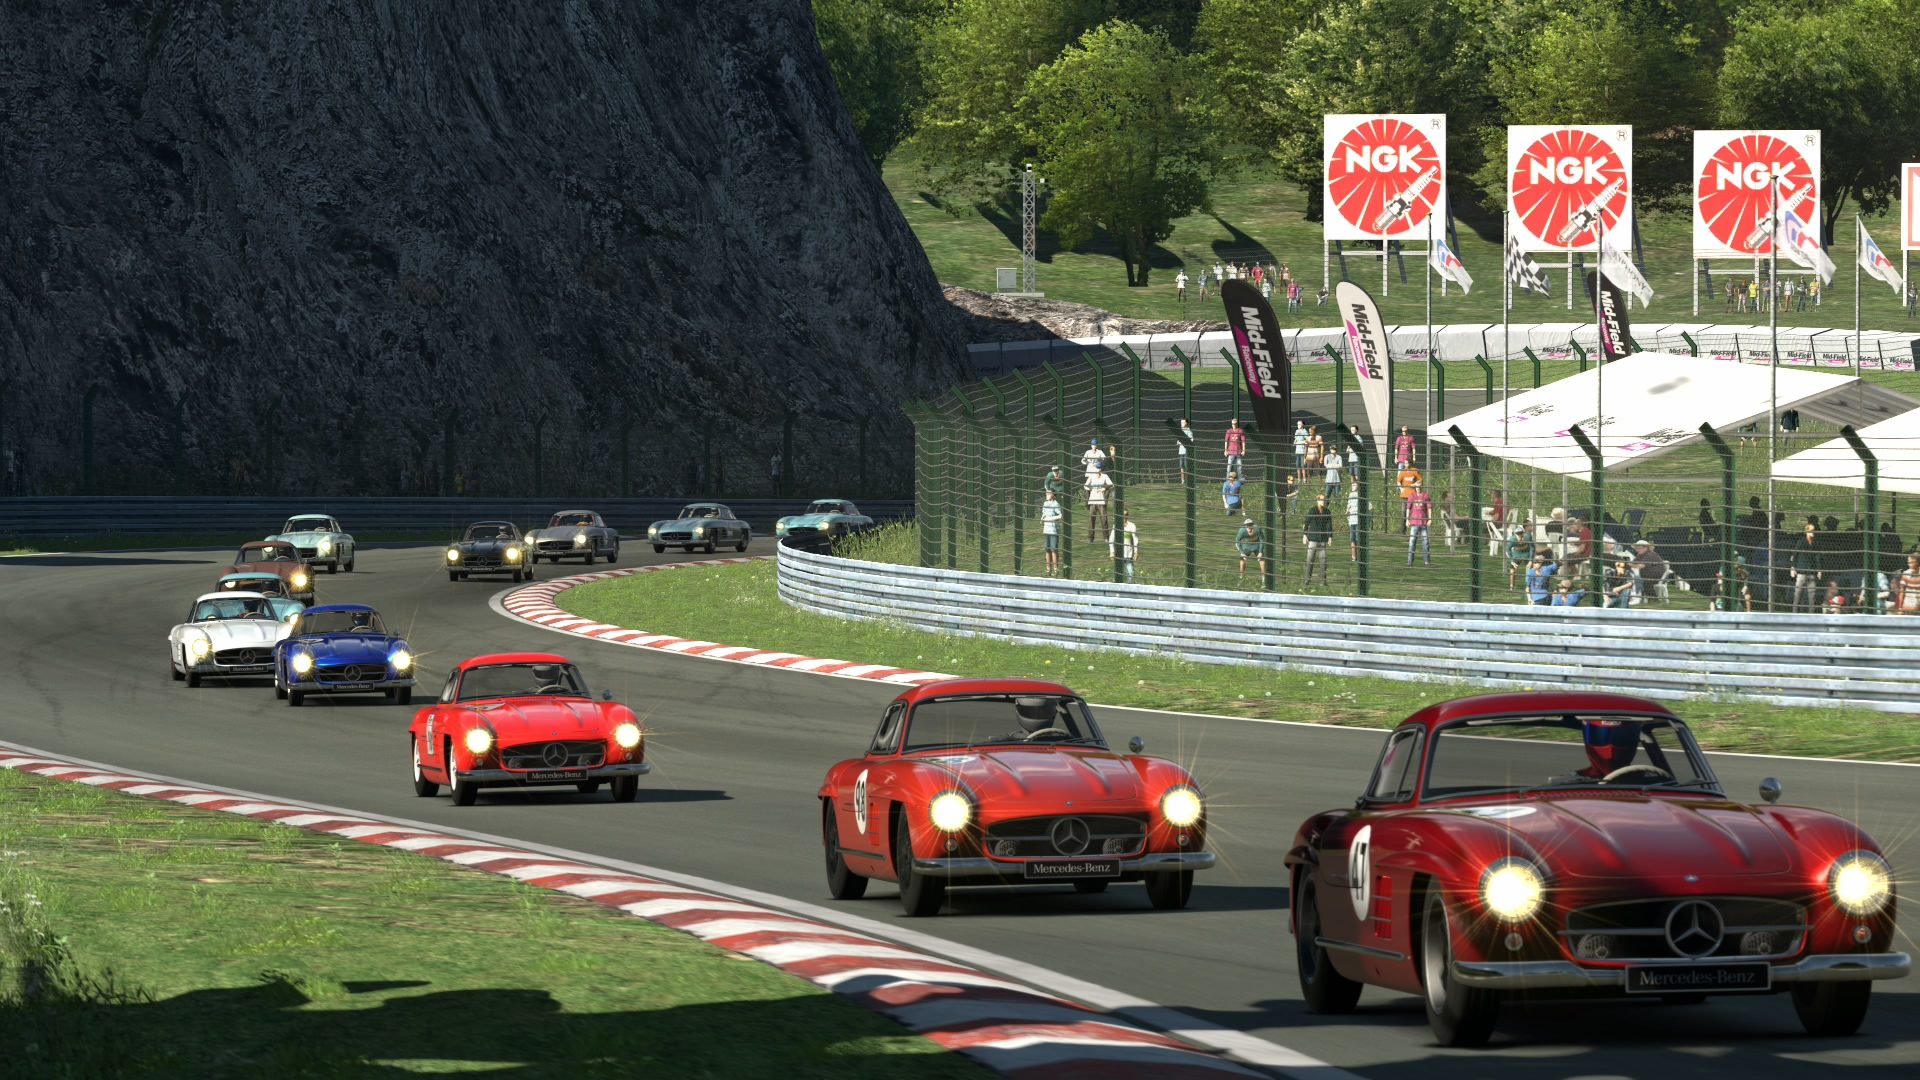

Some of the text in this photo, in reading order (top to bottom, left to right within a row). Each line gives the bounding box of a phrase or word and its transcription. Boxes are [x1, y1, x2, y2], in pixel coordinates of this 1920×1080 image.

[1345, 144, 1423, 174] NGK
[1529, 155, 1609, 186] NGK
[1716, 160, 1796, 191] NGK
[1601, 290, 1626, 355] Mid-Field
[1240, 306, 1281, 399] Mid-Field
[1351, 303, 1384, 381] Mid-Field
[1241, 345, 1256, 384] Raceway
[1033, 863, 1111, 874] Mercedes-Benz
[1639, 969, 1756, 986] Mercedes-Benz
